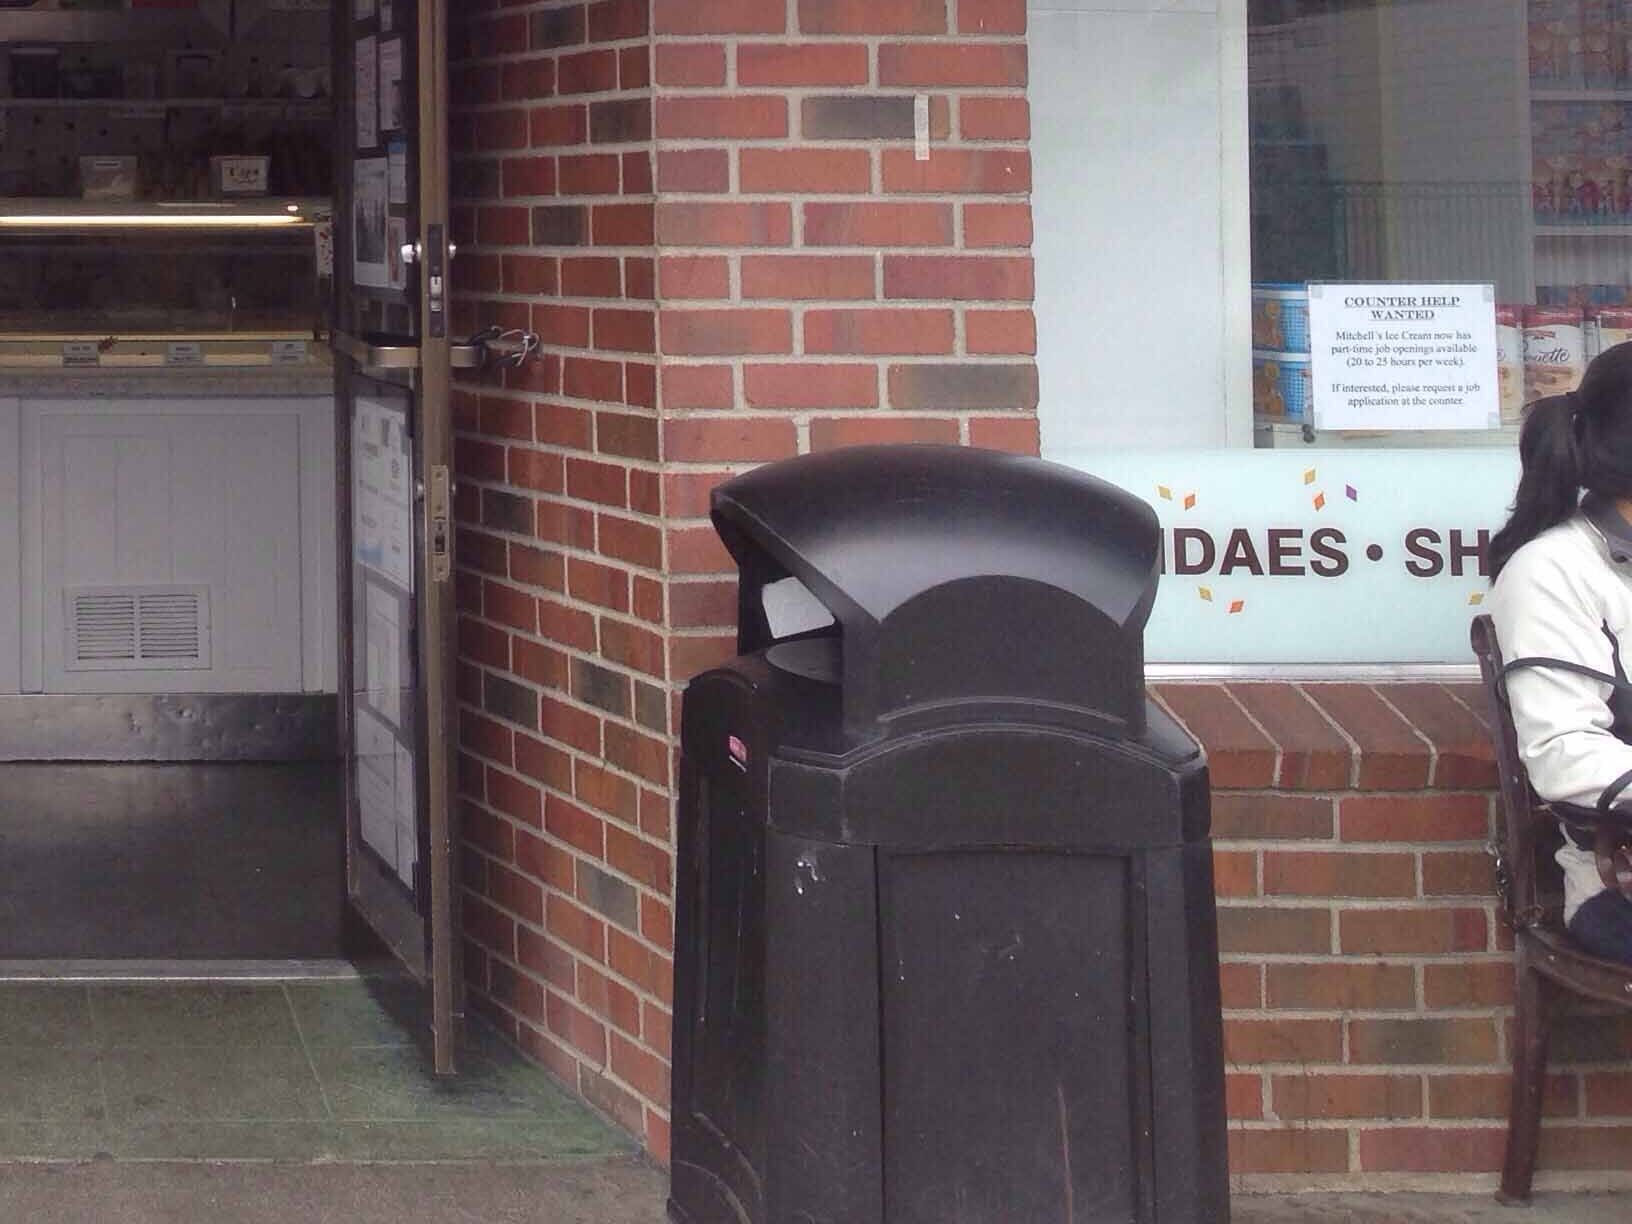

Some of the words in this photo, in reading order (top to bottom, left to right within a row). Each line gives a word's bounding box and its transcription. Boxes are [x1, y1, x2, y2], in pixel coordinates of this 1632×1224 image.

[1344, 296, 1417, 307] COUNTER
[1422, 296, 1460, 307] HELP
[1370, 310, 1435, 320] WANTED
[1385, 331, 1399, 341] Ice
[1401, 331, 1432, 341] Cream
[1456, 331, 1472, 340] has
[1331, 345, 1373, 355] part-time
[1375, 345, 1390, 356] job
[1393, 345, 1434, 355] openings
[1436, 344, 1477, 353] available
[1346, 357, 1362, 367] (20
[1364, 358, 1374, 366] to
[1376, 357, 1388, 366] 25
[1390, 357, 1416, 366] hours
[1418, 359, 1432, 368] per
[1332, 383, 1341, 392] If
[1392, 383, 1420, 394] please
[1423, 384, 1455, 394] request
[1465, 383, 1480, 394] job
[1348, 396, 1398, 408] application
[1401, 397, 1410, 405] at
[1412, 396, 1426, 405] the
[1404, 528, 1491, 578] SH
